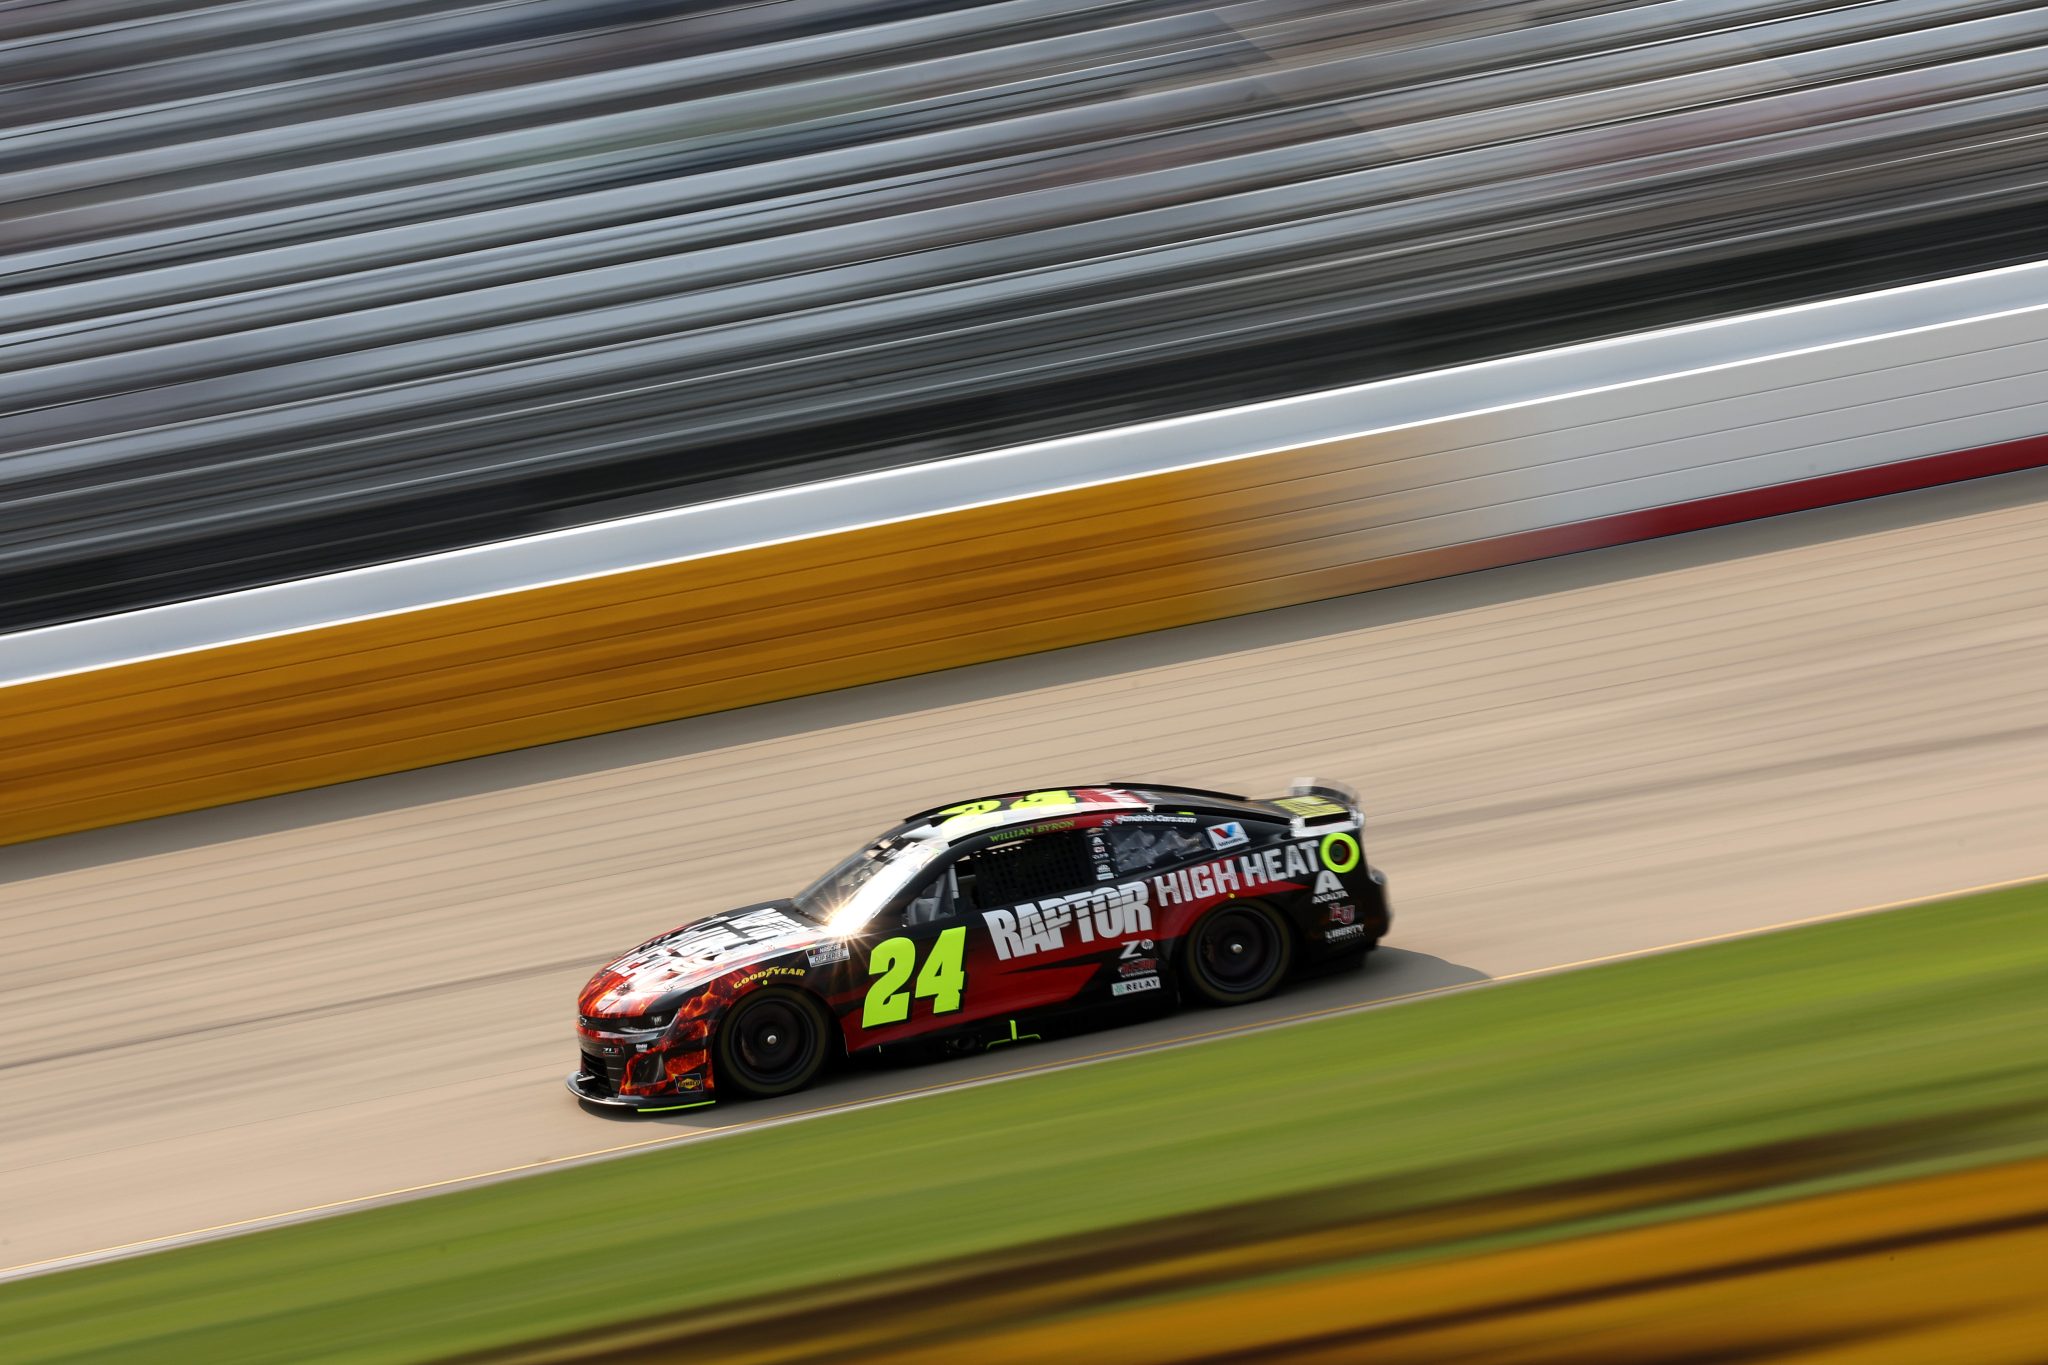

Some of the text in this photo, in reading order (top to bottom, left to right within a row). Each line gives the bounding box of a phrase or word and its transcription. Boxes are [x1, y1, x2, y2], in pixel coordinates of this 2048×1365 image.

[989, 820, 1075, 843] WILLIAM BYRON
[982, 840, 1320, 961] RAPTOR HIGH HEAT
[1311, 889, 1350, 905] AXALTA
[1324, 923, 1365, 940] LIBERTY
[1119, 940, 1143, 960] Z
[733, 965, 806, 989] GOODYEAR
[862, 926, 967, 1029] 24
[1126, 979, 1158, 992] RELAY
